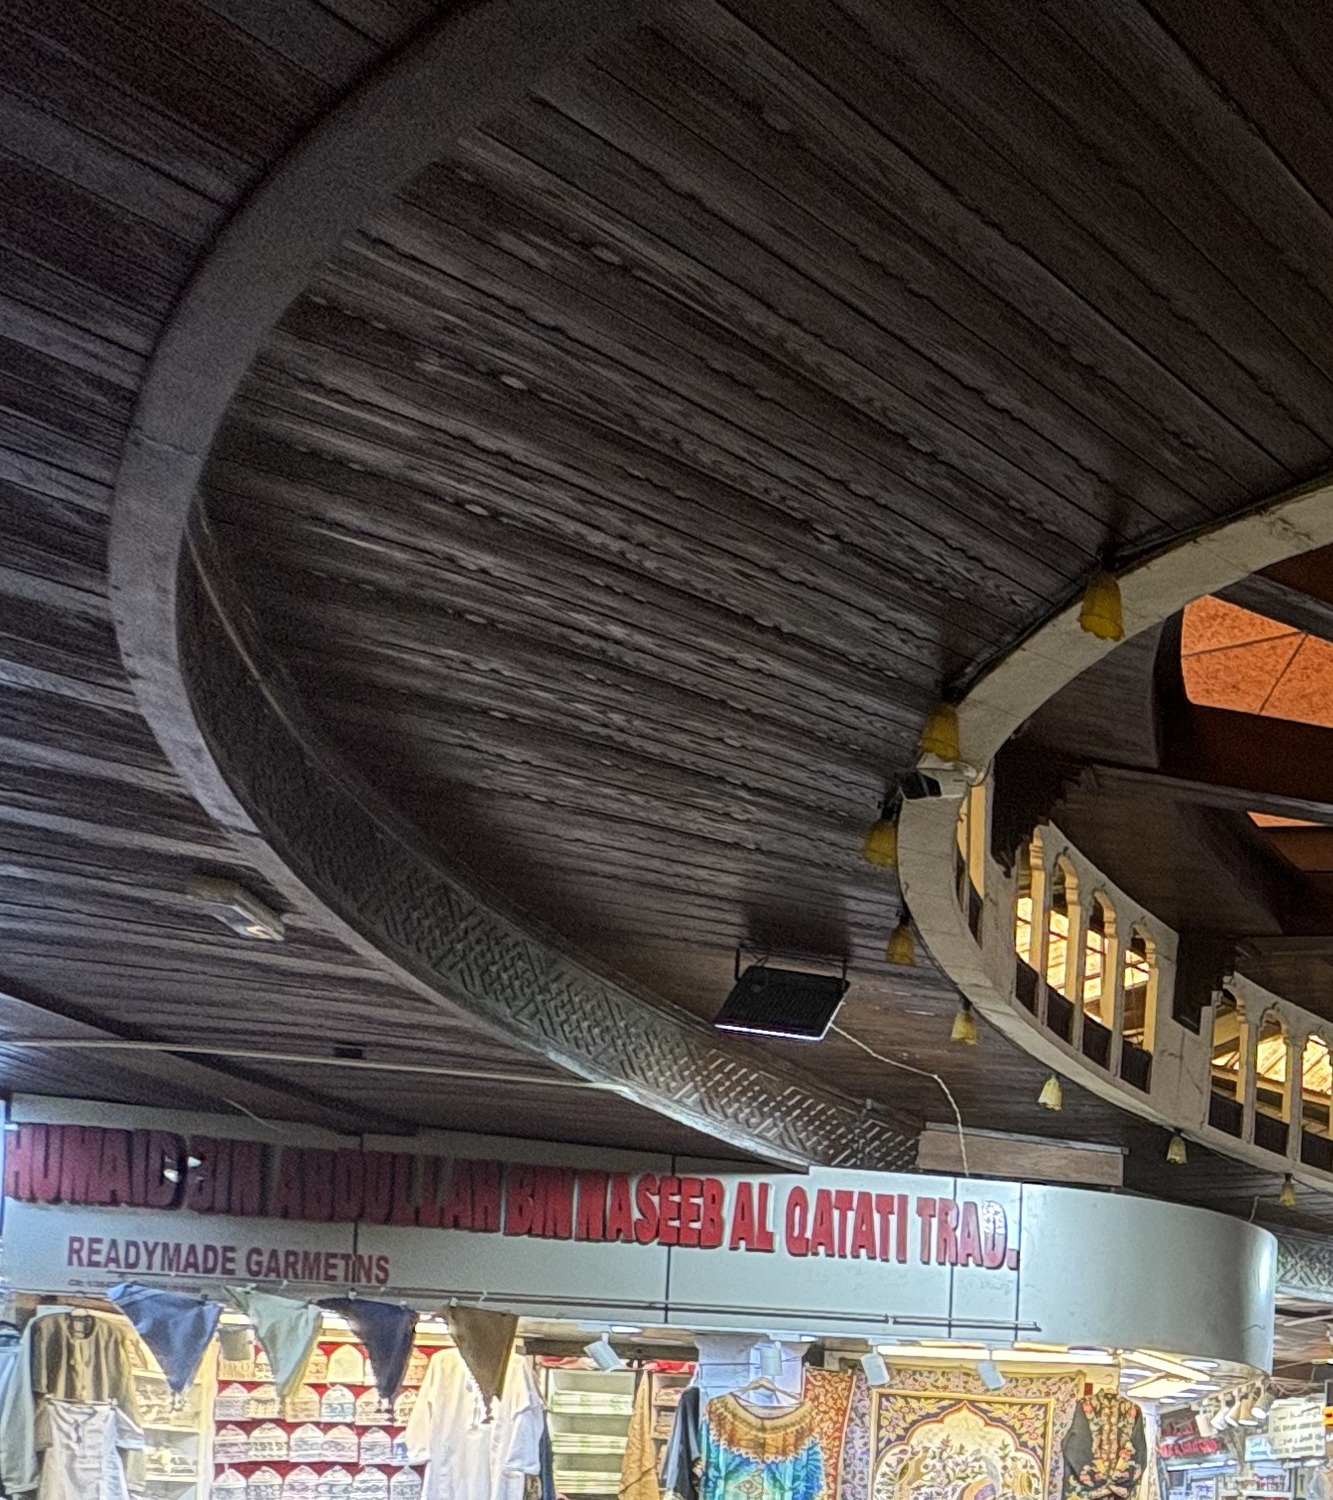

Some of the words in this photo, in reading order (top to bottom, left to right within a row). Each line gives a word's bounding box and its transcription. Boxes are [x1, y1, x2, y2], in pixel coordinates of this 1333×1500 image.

[5, 1122, 186, 1209] HUMAID
[276, 1144, 503, 1234] ABDULLAH
[503, 1161, 573, 1241] BIN
[573, 1168, 725, 1250] NASEEB
[728, 1181, 777, 1253] AL
[785, 1185, 909, 1263] QATATI
[916, 1196, 1020, 1271] TRAD.
[66, 1235, 237, 1277] READYMADE
